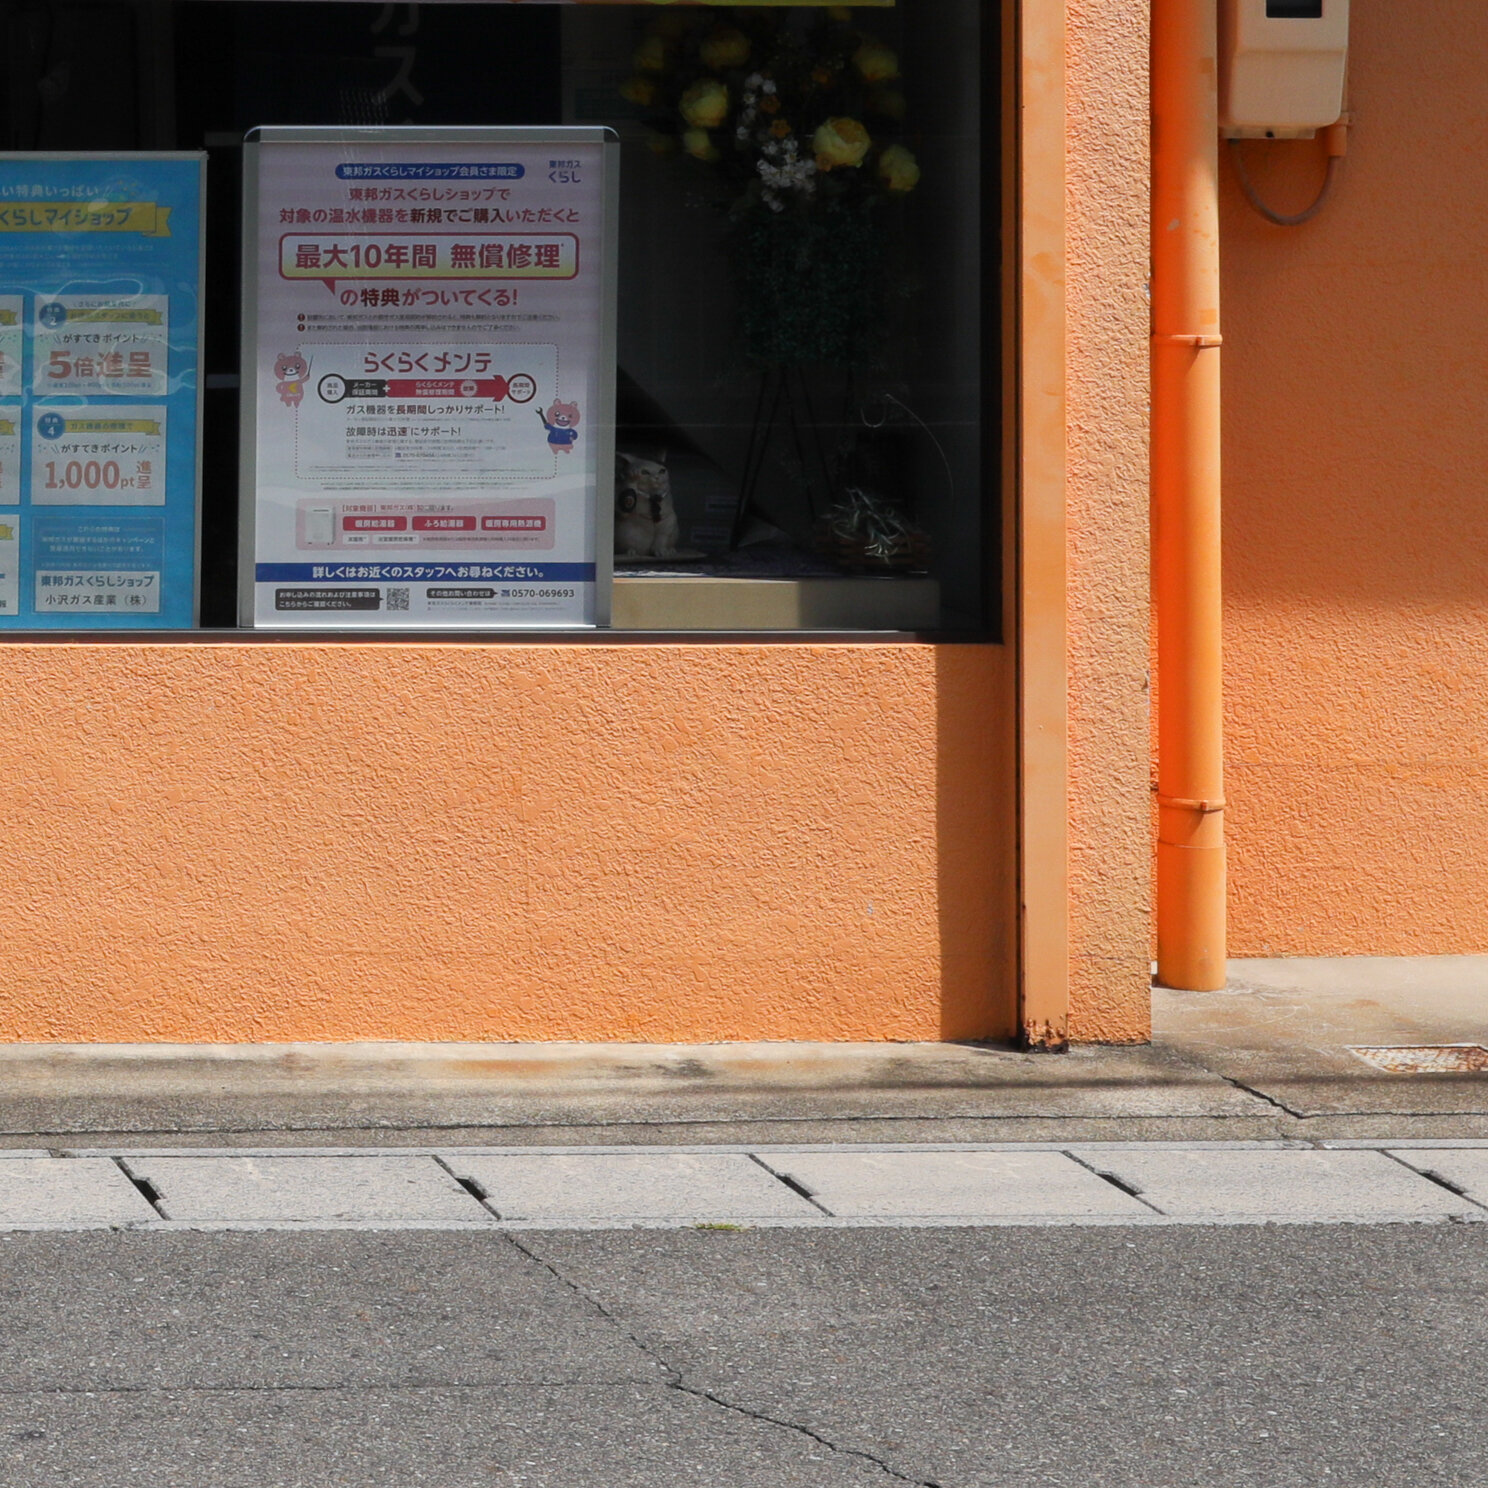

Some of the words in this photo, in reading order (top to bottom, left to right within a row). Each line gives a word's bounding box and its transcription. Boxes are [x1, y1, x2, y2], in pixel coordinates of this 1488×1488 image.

[343, 165, 517, 177] 東邦ガスくらしマイショップ会員さま限定
[548, 172, 581, 183] くらし
[349, 187, 511, 201] 東邦ガスくらしショップで
[279, 208, 580, 224] 対象の温水機器を新規でご購入いただくと
[295, 243, 437, 269] 最大10年間
[451, 243, 560, 269] 無償修理
[341, 287, 517, 307] の特典がついてくる！
[49, 317, 57, 326] 2
[63, 333, 140, 344] がすてきポイント
[48, 350, 152, 379] 5倍進呈
[364, 352, 492, 373] らくらくメンテ
[346, 404, 505, 415] ガス機器を長期間しっかりサポート！
[47, 425, 56, 436] 4
[62, 444, 138, 453] がすてきポイント
[312, 566, 545, 579] 詳しくはお近くのスタッフへお尋ねください。
[41, 576, 155, 587] 東邦ガスくらしショップ
[511, 588, 575, 598] 0570-069693
